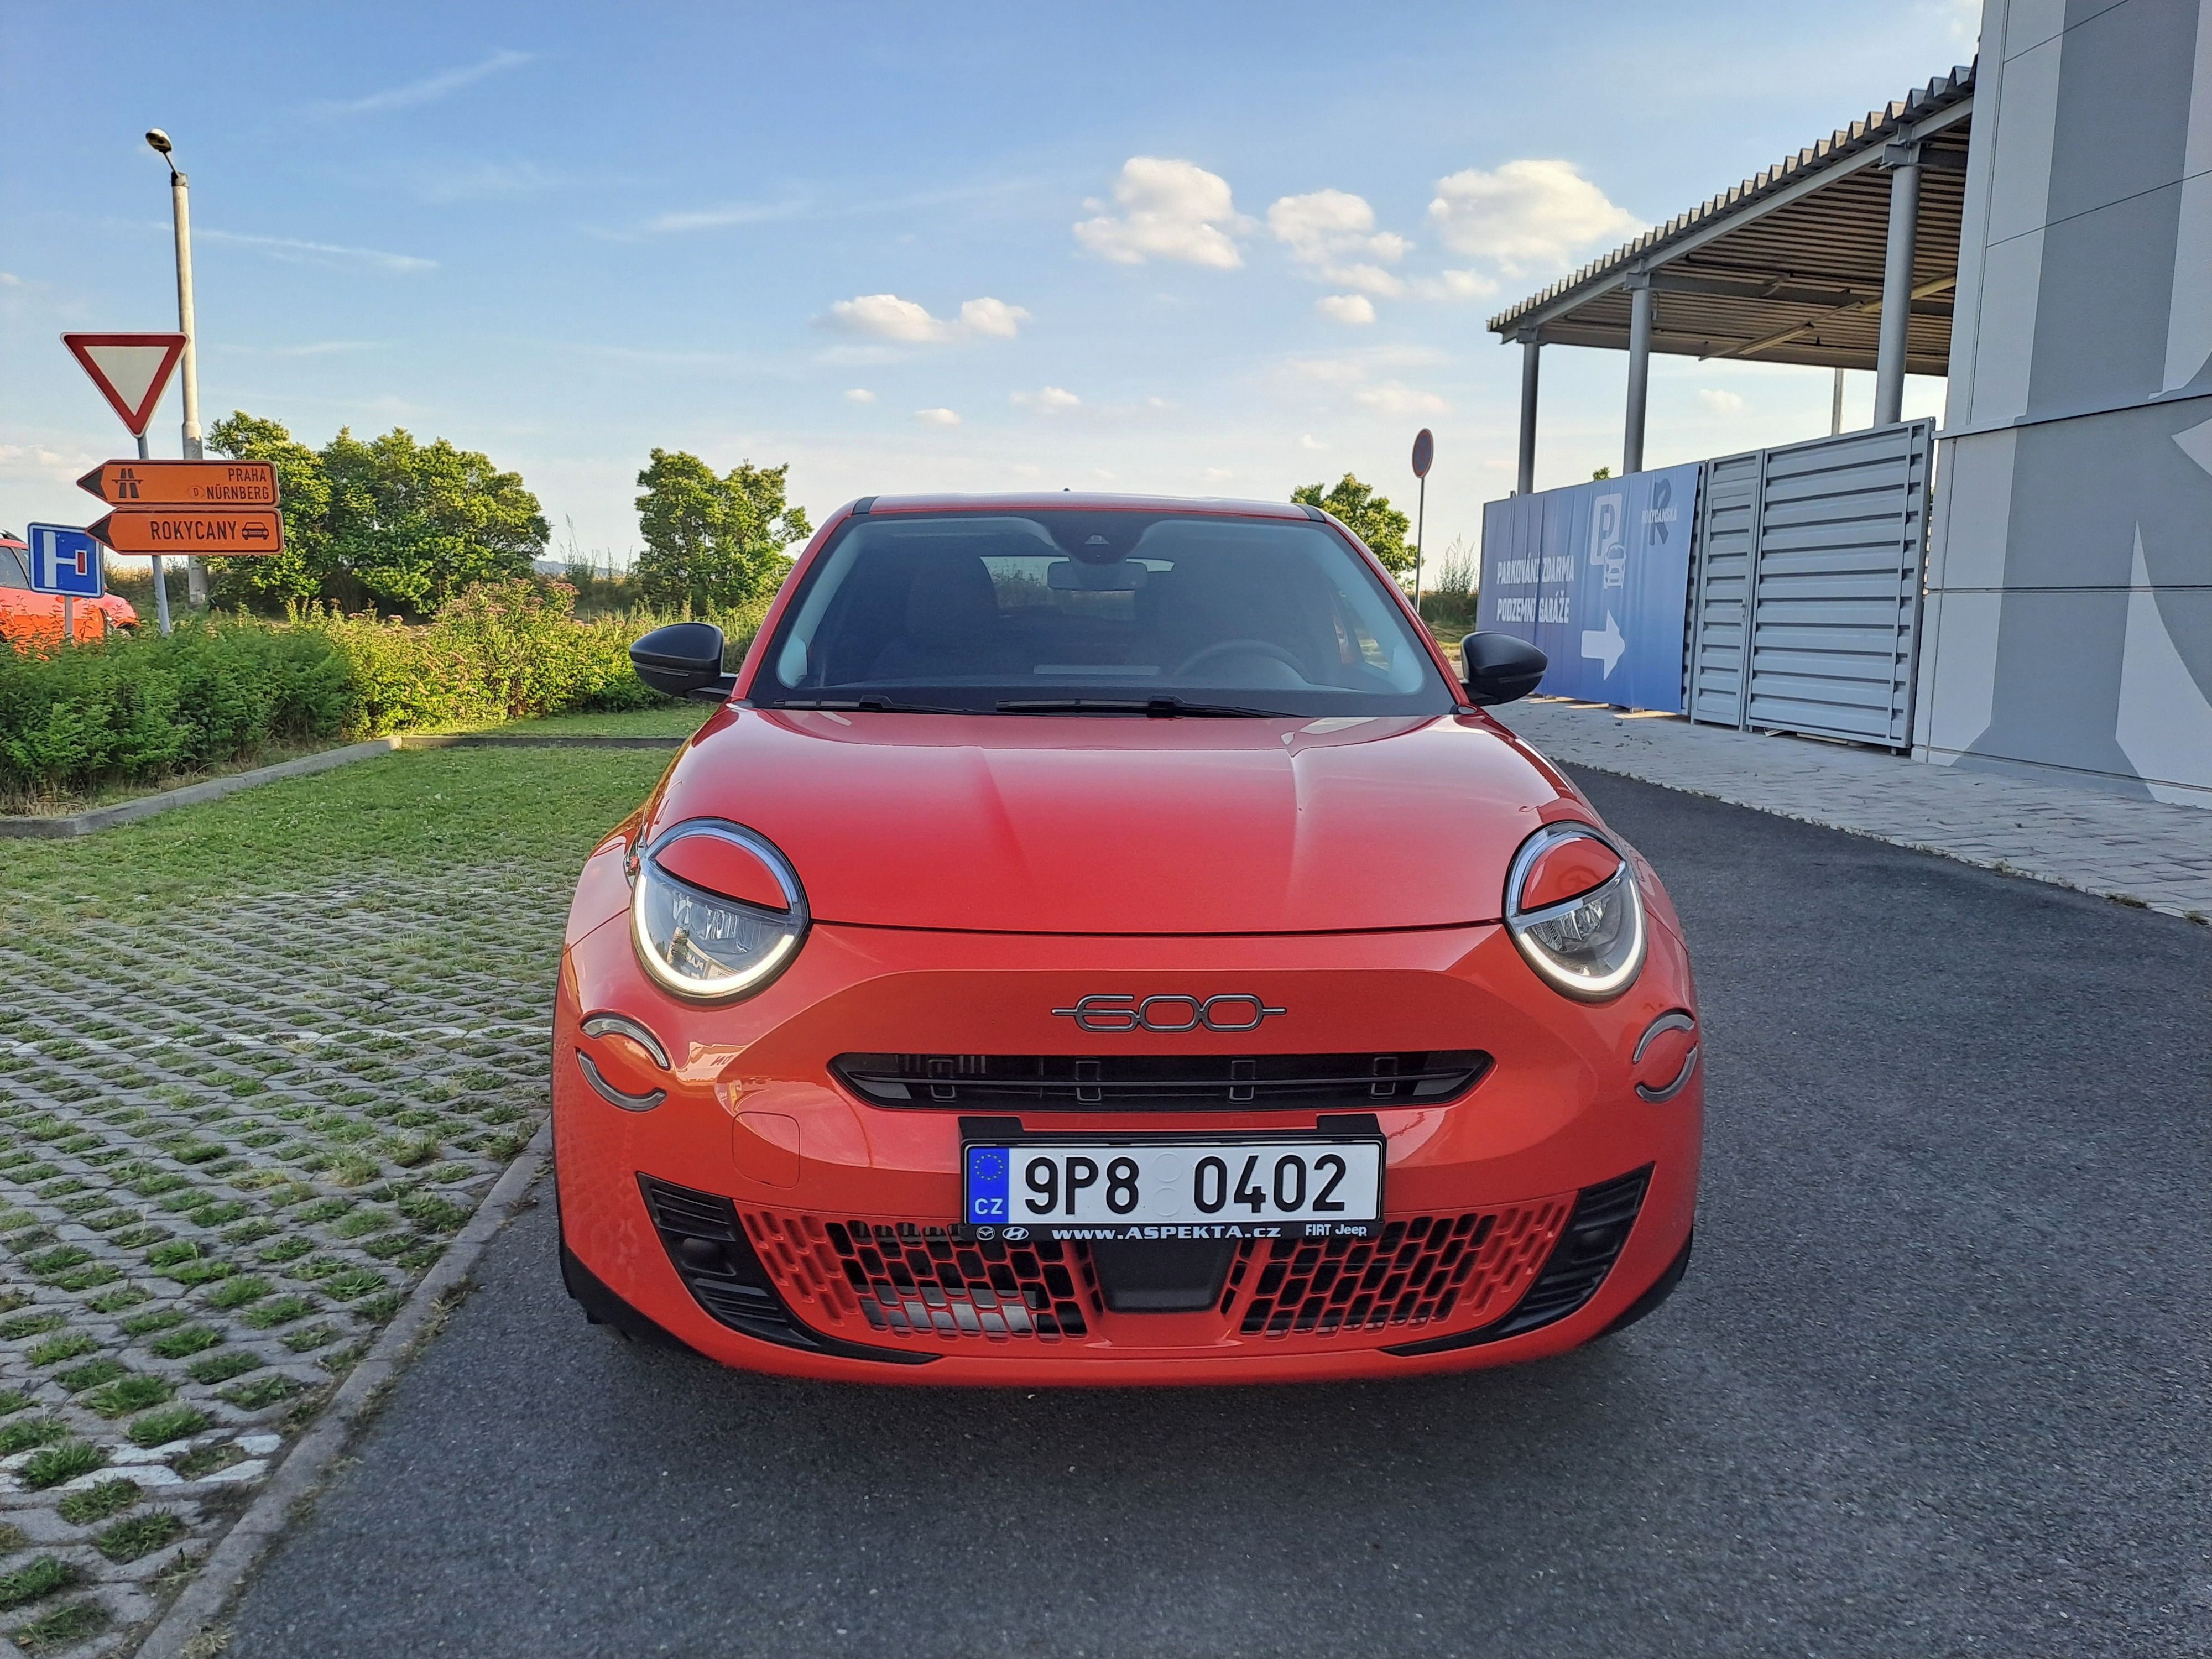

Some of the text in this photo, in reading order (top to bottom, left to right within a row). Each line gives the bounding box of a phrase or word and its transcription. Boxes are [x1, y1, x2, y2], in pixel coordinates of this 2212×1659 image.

[228, 468, 267, 482] PRAHA
[193, 483, 269, 499] D NÜRNBERG
[150, 520, 237, 540] ROKYCANY
[1541, 555, 1575, 583] ZDARMA
[1538, 590, 1571, 624] GARÁŽE
[1072, 994, 1267, 1032] 600
[1025, 1154, 1347, 1215] 9P8 0402
[974, 1197, 1003, 1215] CZ
[1052, 1225, 1282, 1240] www.ASPEKTA.cz
[1305, 1224, 1368, 1237] FIAT Jeep
